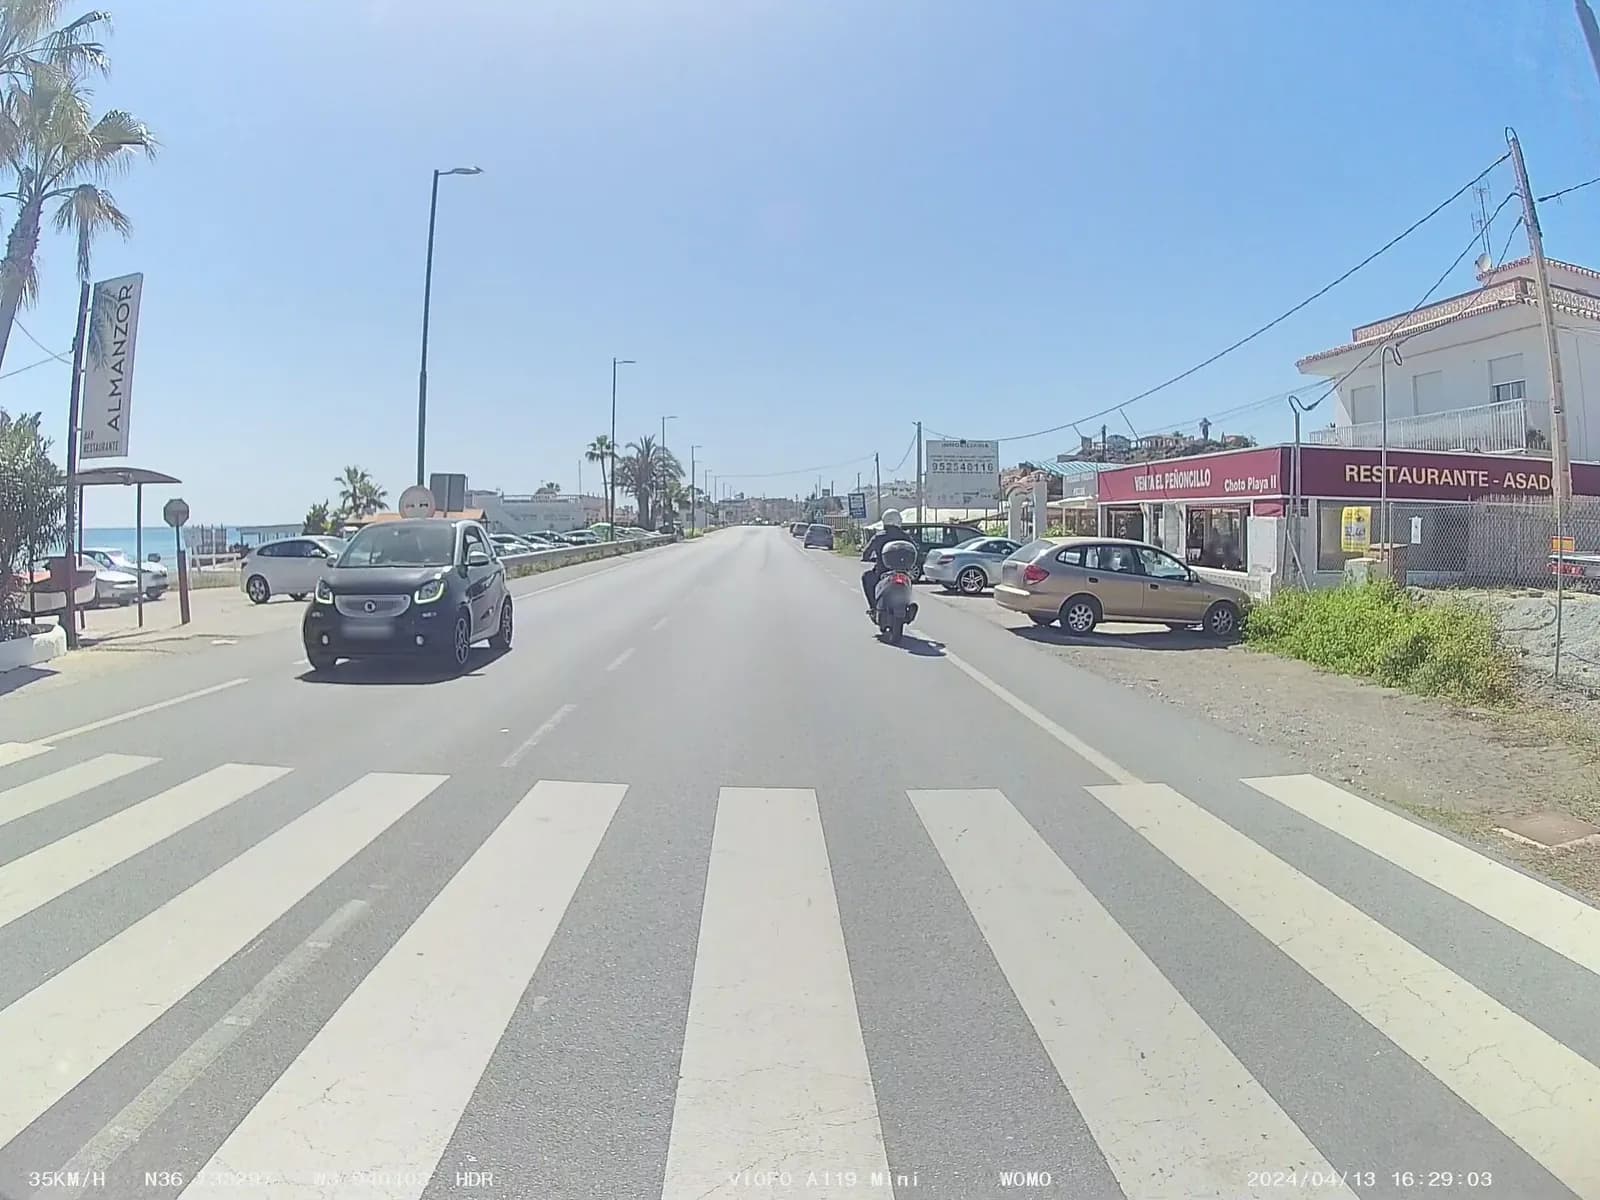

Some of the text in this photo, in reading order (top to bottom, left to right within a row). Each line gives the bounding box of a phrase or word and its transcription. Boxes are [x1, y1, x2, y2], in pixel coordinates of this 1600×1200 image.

[107, 284, 133, 432] ALMANZOR
[83, 440, 119, 453] RESTAURANTE
[932, 462, 994, 471] 952540116
[1134, 469, 1211, 491] VENTA EL PEÑONCILLO
[1224, 478, 1246, 492] Choto
[1247, 476, 1269, 493] Playa
[1345, 464, 1489, 487] RESTAURANTE
[1503, 472, 1553, 490] ASAD
